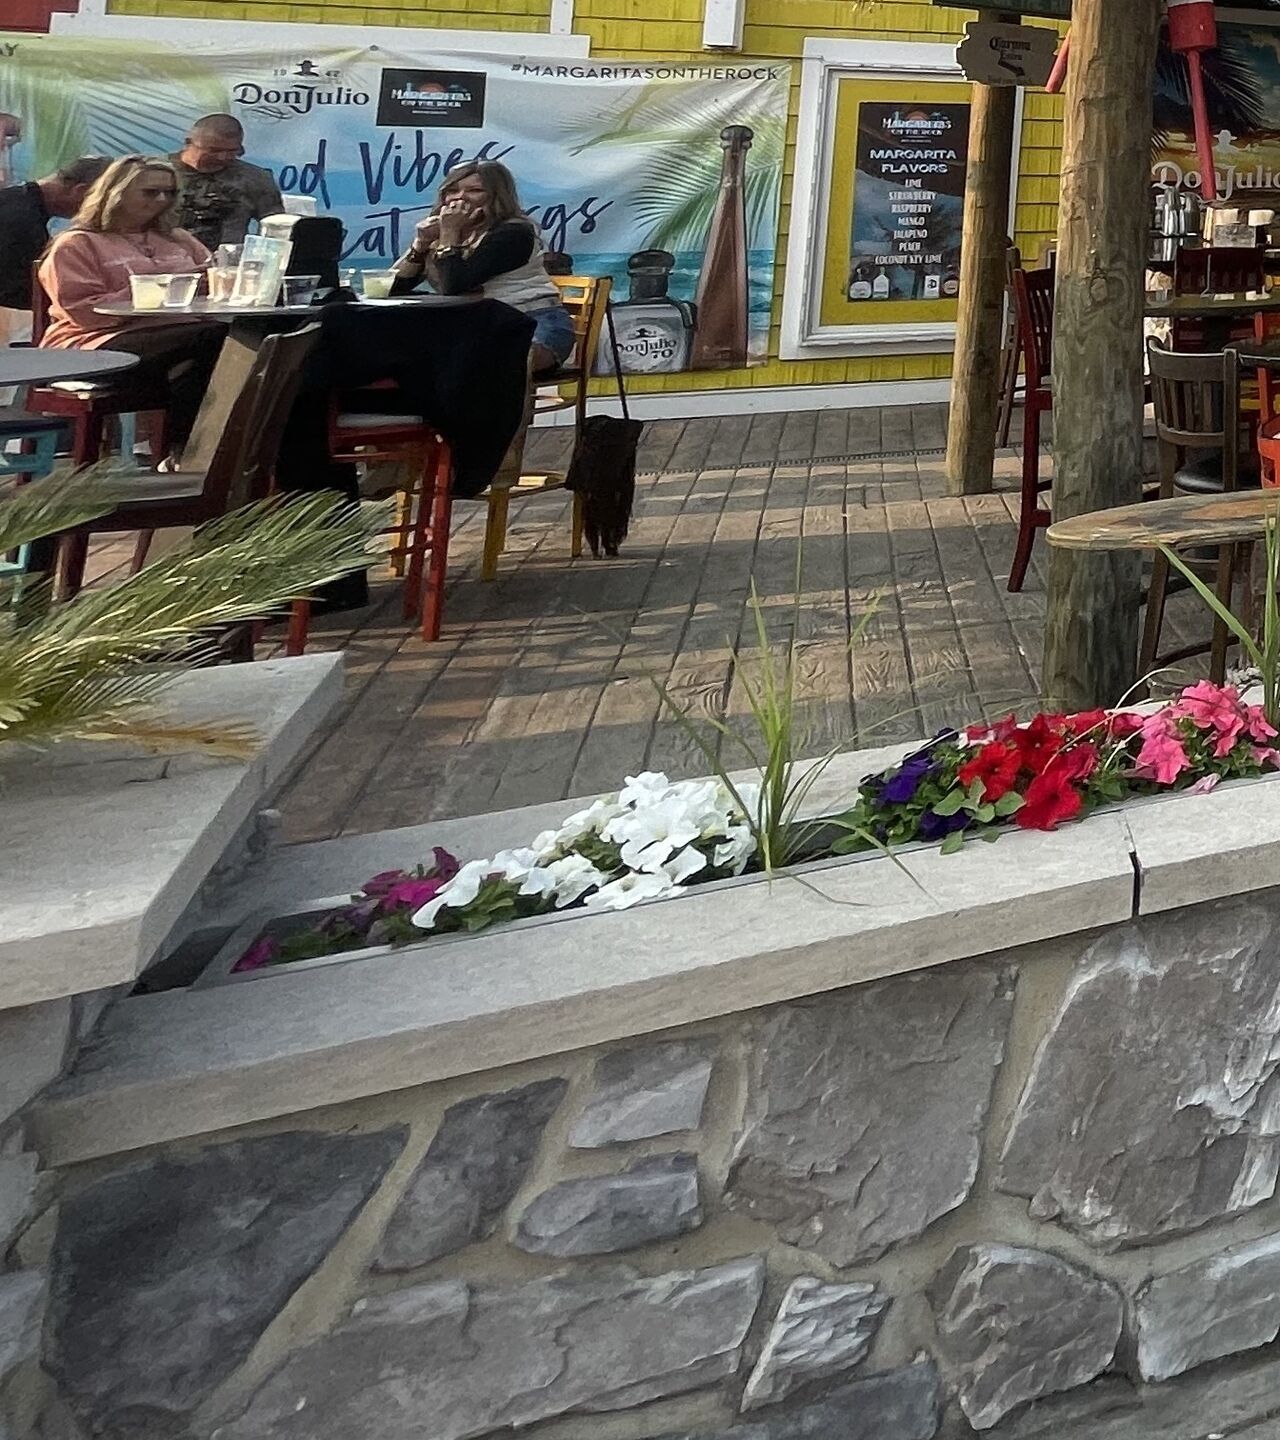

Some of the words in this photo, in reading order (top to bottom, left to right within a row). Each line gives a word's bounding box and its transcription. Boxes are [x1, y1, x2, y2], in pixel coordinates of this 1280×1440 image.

[511, 62, 778, 81] #MARGARITASONTHEROCK
[869, 149, 957, 160] MARGARITA
[881, 163, 949, 174] FLAVORS
[905, 178, 922, 188] LIME
[898, 216, 925, 226] MANGO
[898, 241, 921, 252] PEACH
